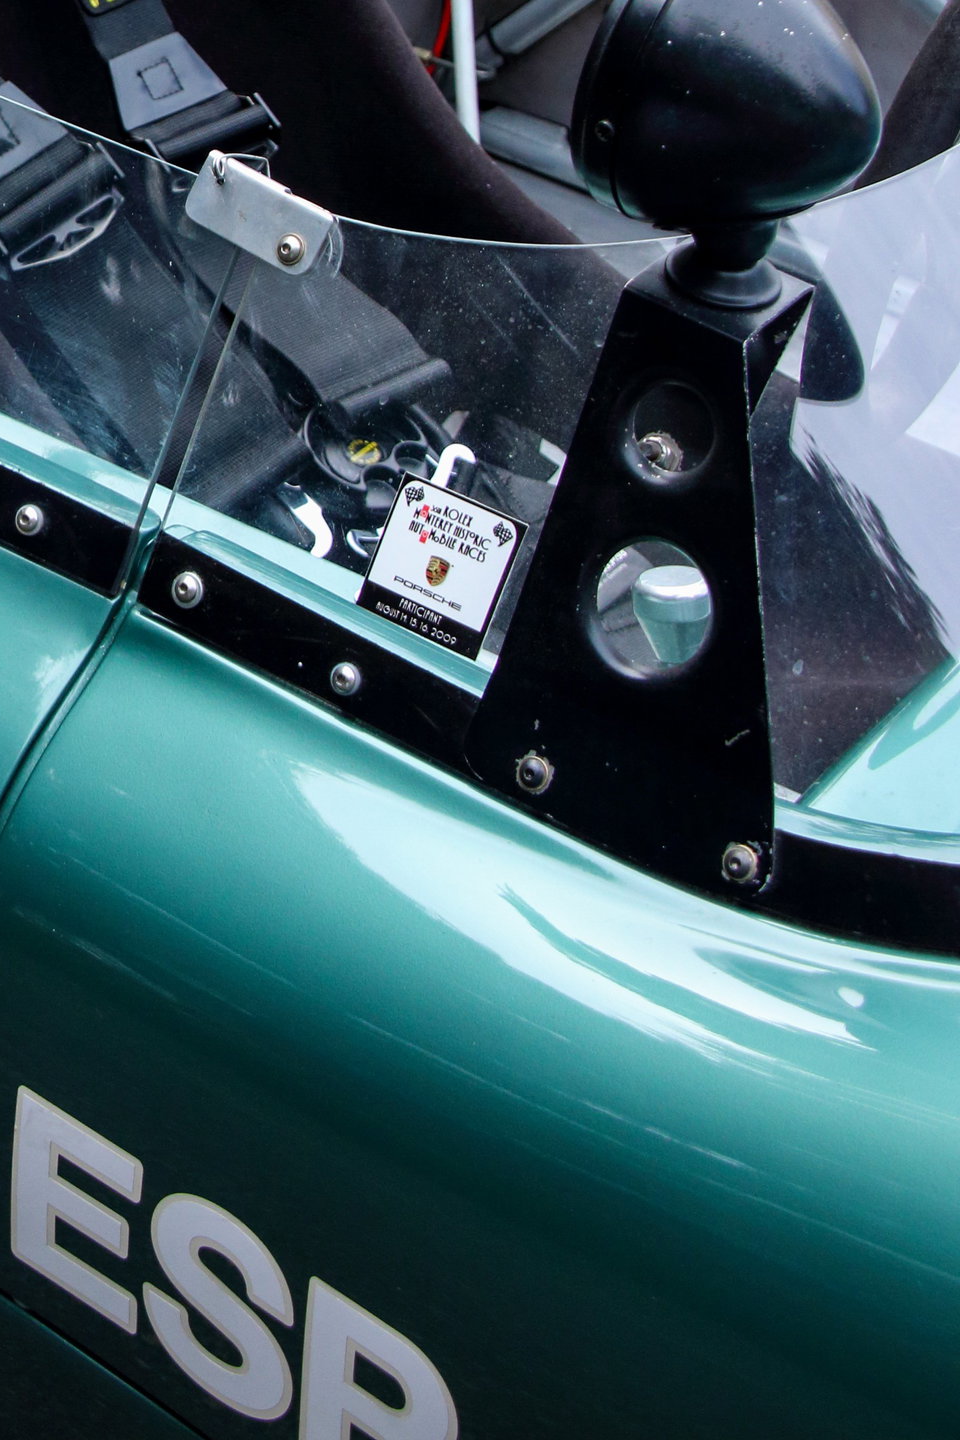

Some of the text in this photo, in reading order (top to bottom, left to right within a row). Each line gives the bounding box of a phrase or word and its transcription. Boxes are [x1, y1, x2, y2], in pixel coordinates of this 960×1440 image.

[442, 505, 473, 527] ROLEX
[457, 541, 487, 563] RACES
[393, 575, 462, 611] PORSCHE
[375, 601, 400, 618] AUGUST
[429, 626, 457, 646] 2009
[397, 597, 442, 625] PARTICIPANT
